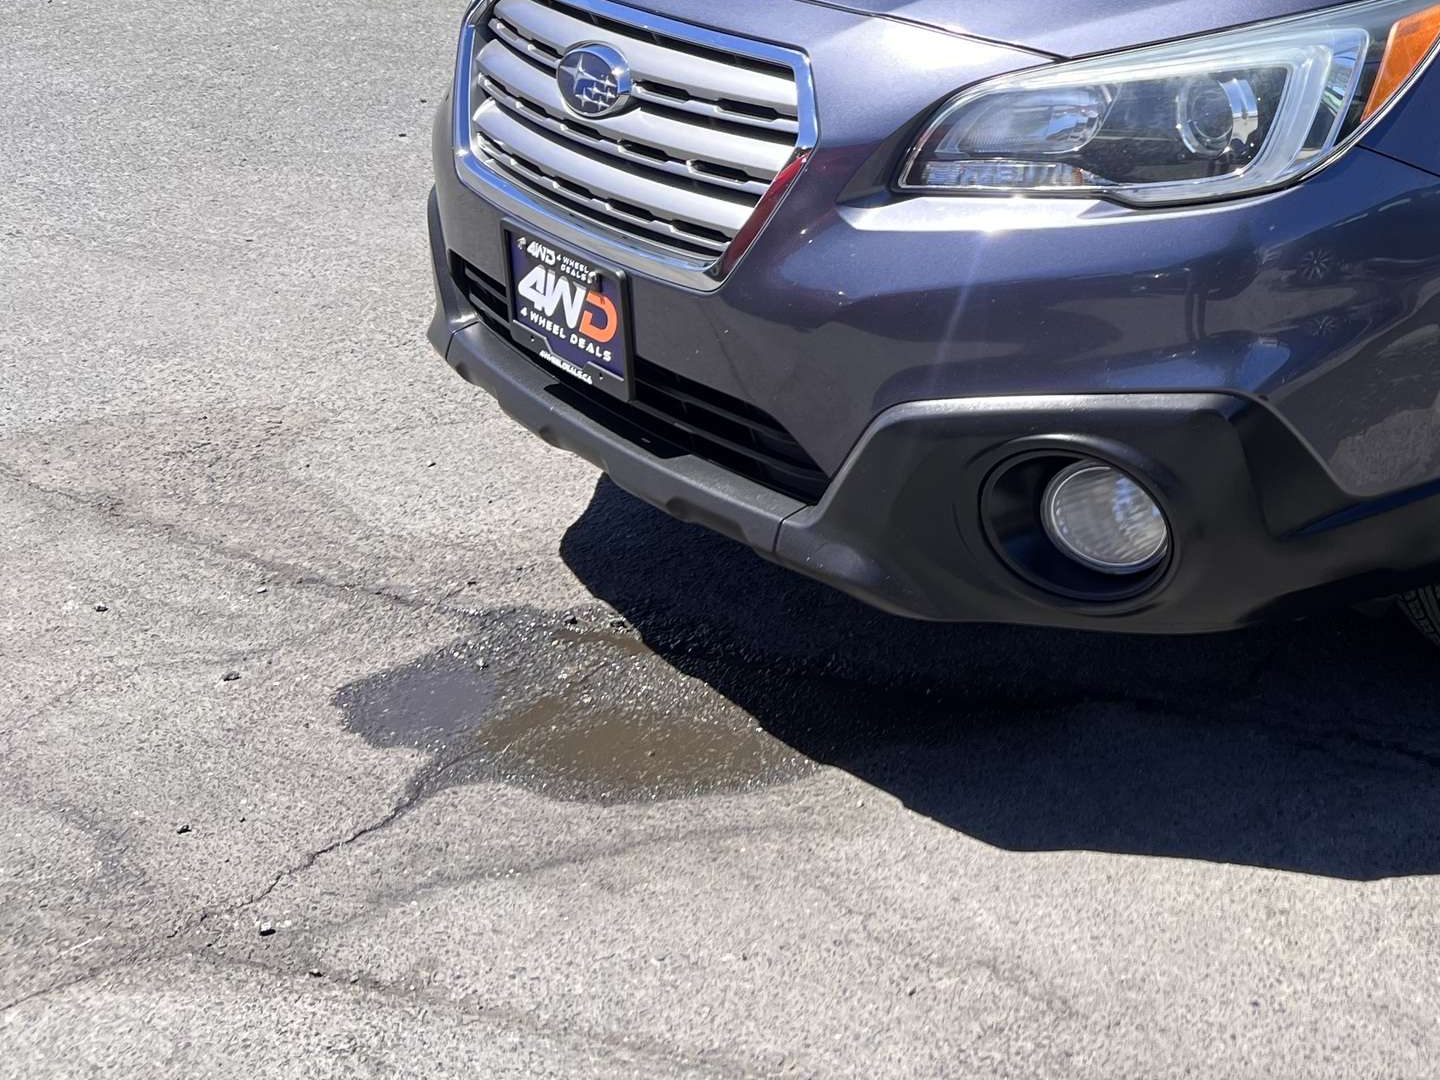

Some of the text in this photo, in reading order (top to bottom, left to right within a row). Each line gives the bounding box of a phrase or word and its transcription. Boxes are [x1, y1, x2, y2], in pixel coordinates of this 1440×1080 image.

[518, 264, 618, 343] 4WD
[520, 306, 613, 362] 4 WHEEL DEALS
